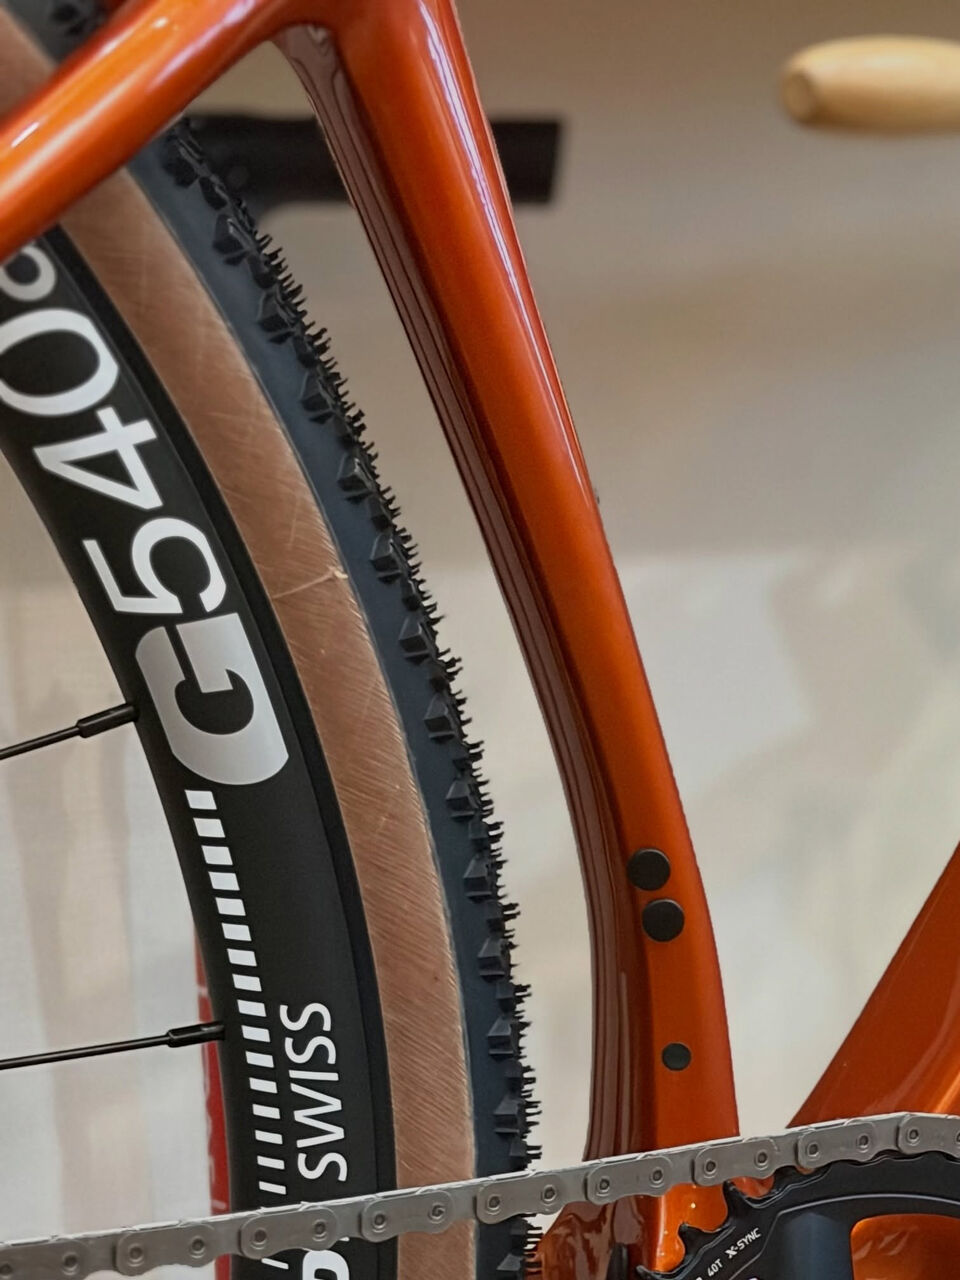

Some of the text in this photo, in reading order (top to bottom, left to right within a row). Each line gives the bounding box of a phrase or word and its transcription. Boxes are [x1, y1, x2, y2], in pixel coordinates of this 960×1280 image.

[279, 1002, 349, 1183] SWISS
[707, 1259, 724, 1277] 40T
[725, 1228, 762, 1259] X-SYNC
